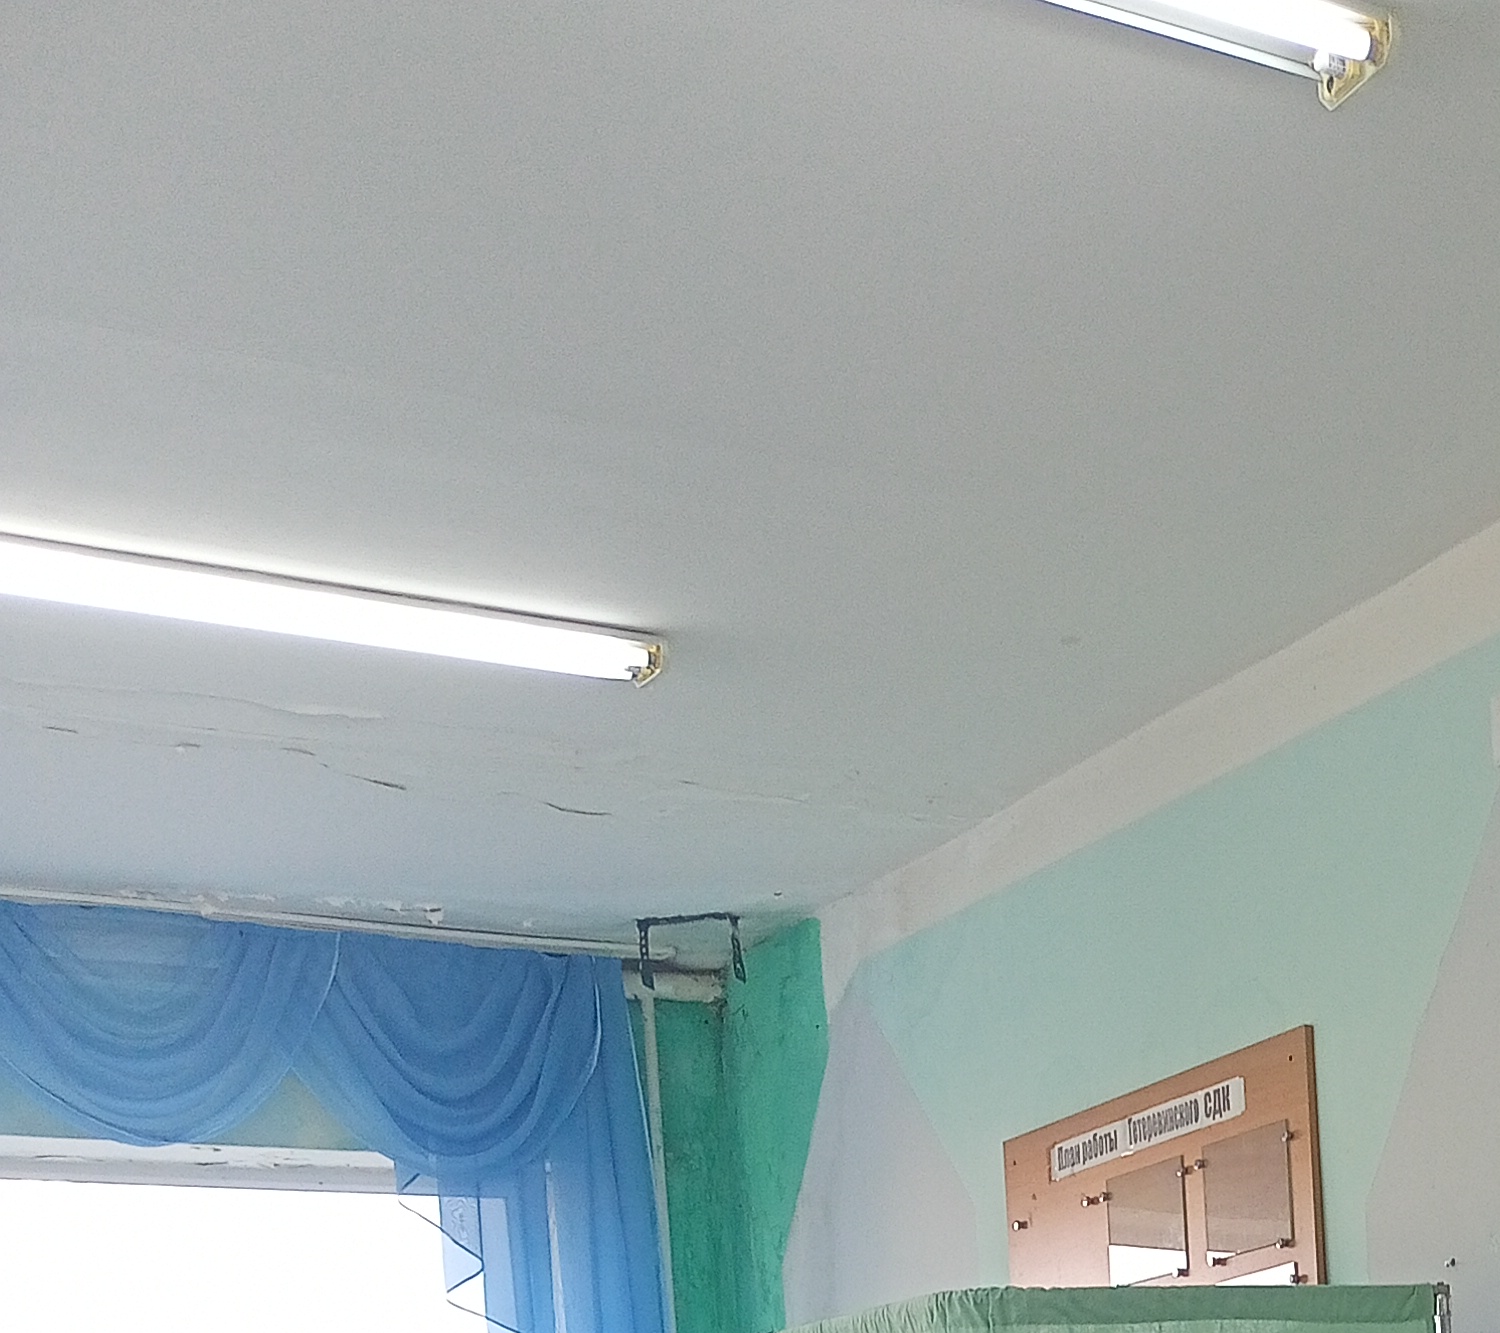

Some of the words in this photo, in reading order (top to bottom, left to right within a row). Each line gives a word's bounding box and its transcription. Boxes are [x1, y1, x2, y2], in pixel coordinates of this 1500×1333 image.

[1057, 1143, 1081, 1171] План
[1081, 1129, 1118, 1165] работы
[1203, 1084, 1231, 1121] СДК
